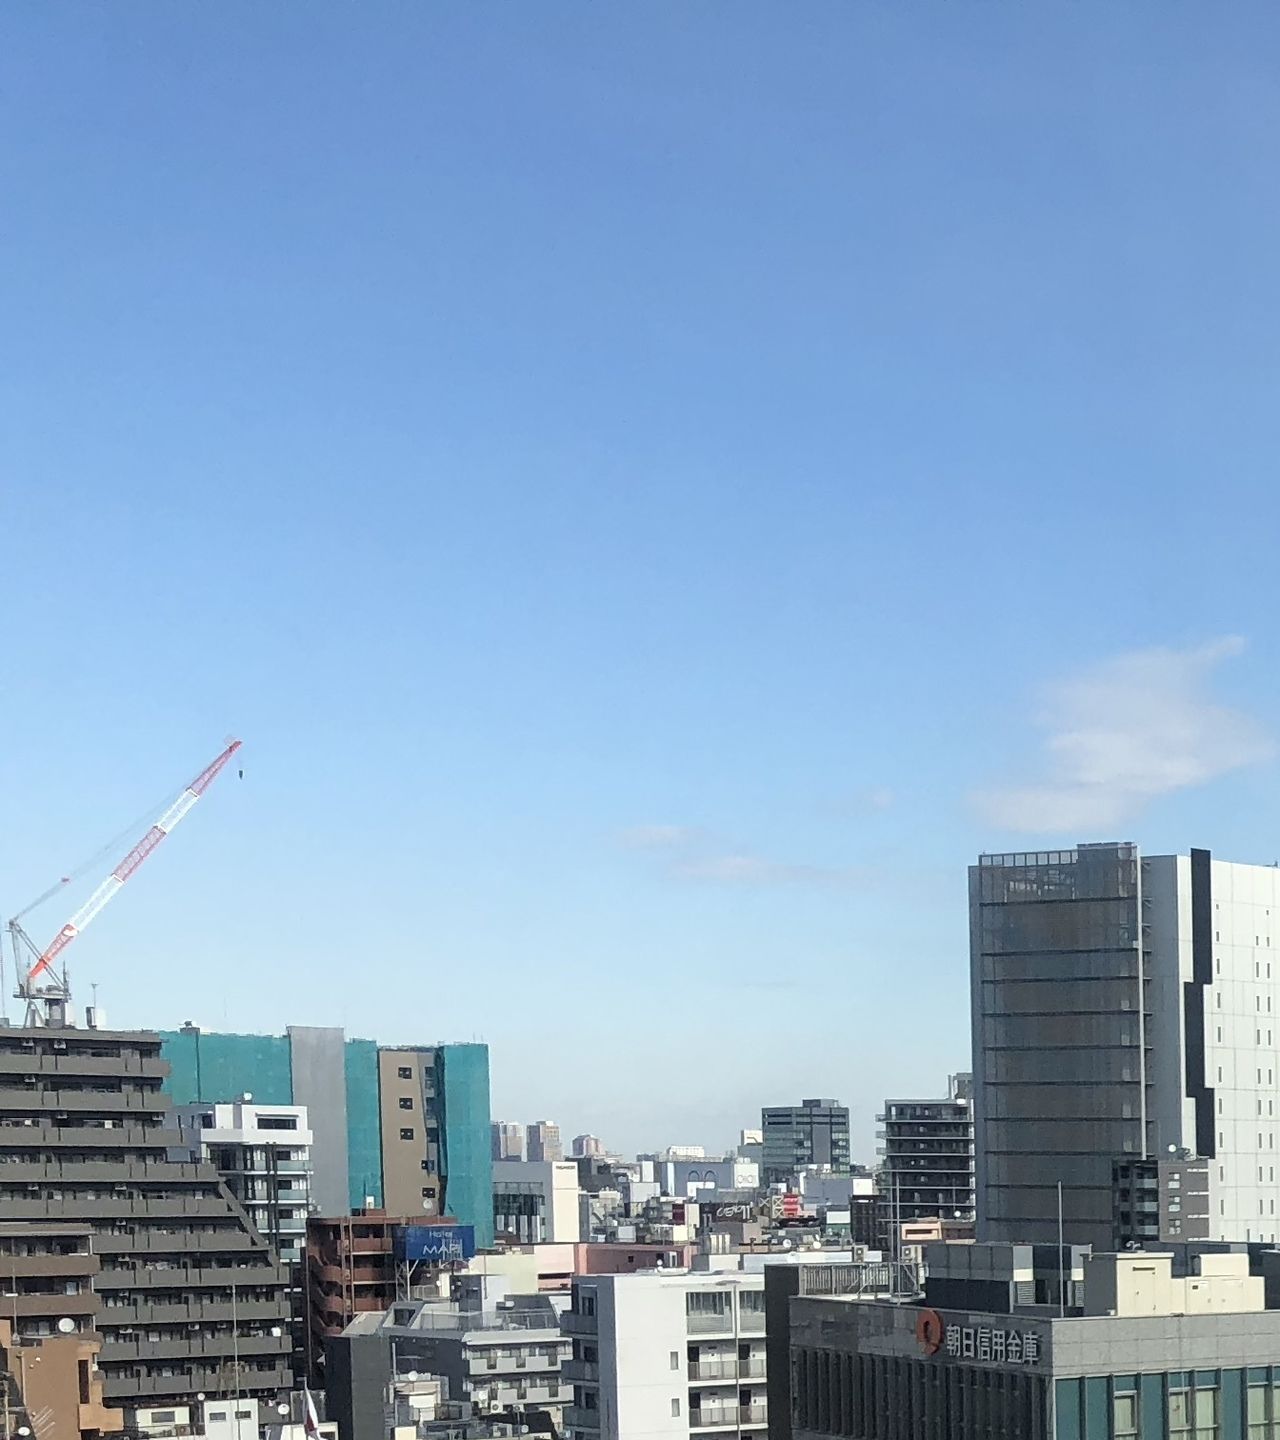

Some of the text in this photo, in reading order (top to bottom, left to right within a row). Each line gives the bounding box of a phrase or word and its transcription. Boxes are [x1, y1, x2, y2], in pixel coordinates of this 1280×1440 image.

[945, 1322, 1040, 1366] 朝日信用金庫
